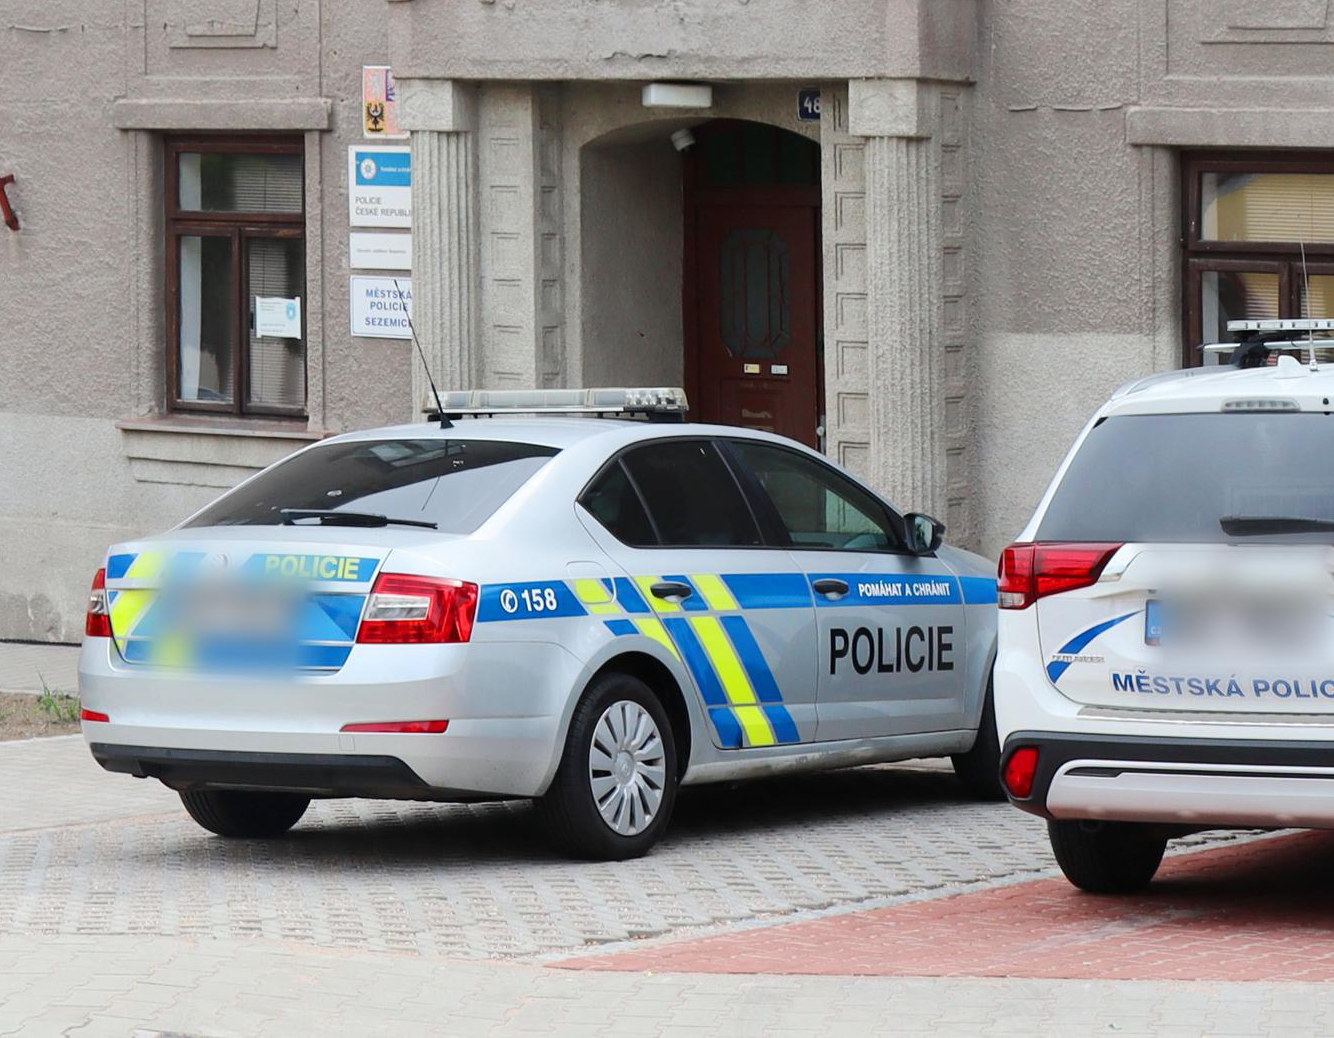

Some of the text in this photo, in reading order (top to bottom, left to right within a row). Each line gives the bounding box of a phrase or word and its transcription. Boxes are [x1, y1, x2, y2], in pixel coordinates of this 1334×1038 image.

[355, 196, 382, 205] POLICIE
[355, 206, 379, 216] ČESKÉ
[365, 287, 412, 300] MĚSTSKÁ
[370, 301, 409, 312] POLICIE
[265, 555, 361, 580] POLICIE
[858, 580, 950, 597] POMÁHAT A CHRÁNIT
[521, 587, 557, 612] 158
[829, 625, 955, 675] POLICIE
[1112, 669, 1245, 697] MĚSTSKÁ
